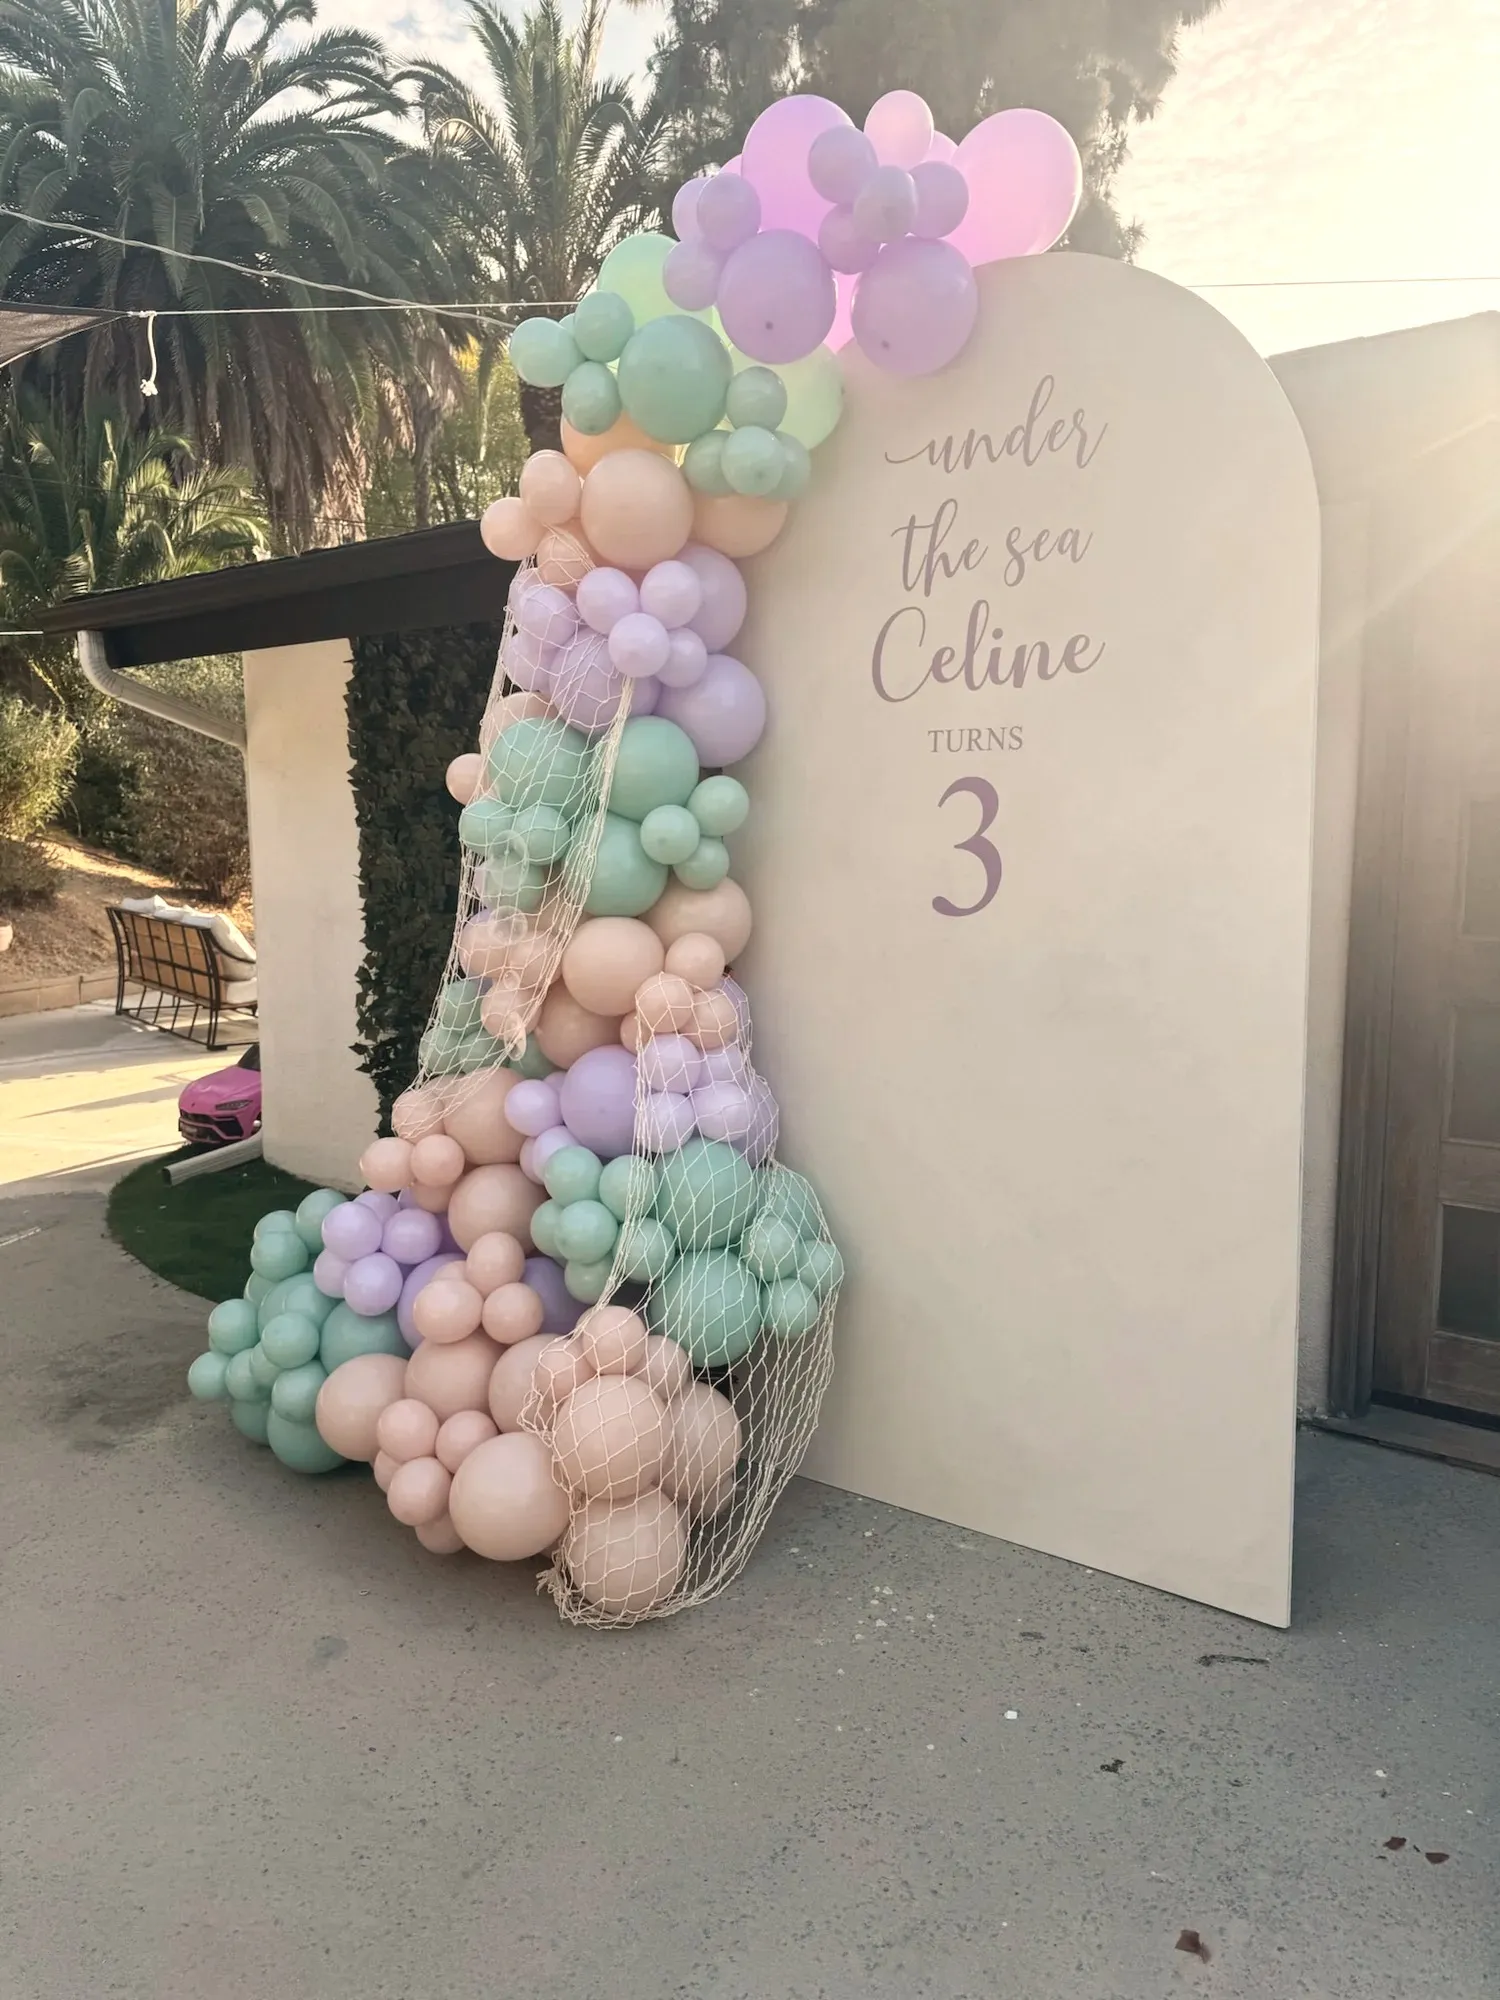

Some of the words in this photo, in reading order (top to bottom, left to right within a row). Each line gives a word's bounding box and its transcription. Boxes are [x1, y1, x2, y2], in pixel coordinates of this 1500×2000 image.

[885, 374, 1108, 473] under
[890, 498, 988, 597] the
[1003, 522, 1094, 588] sea
[872, 599, 1106, 703] Celine
[927, 726, 1023, 753] TURNS
[931, 776, 1003, 918] 3
